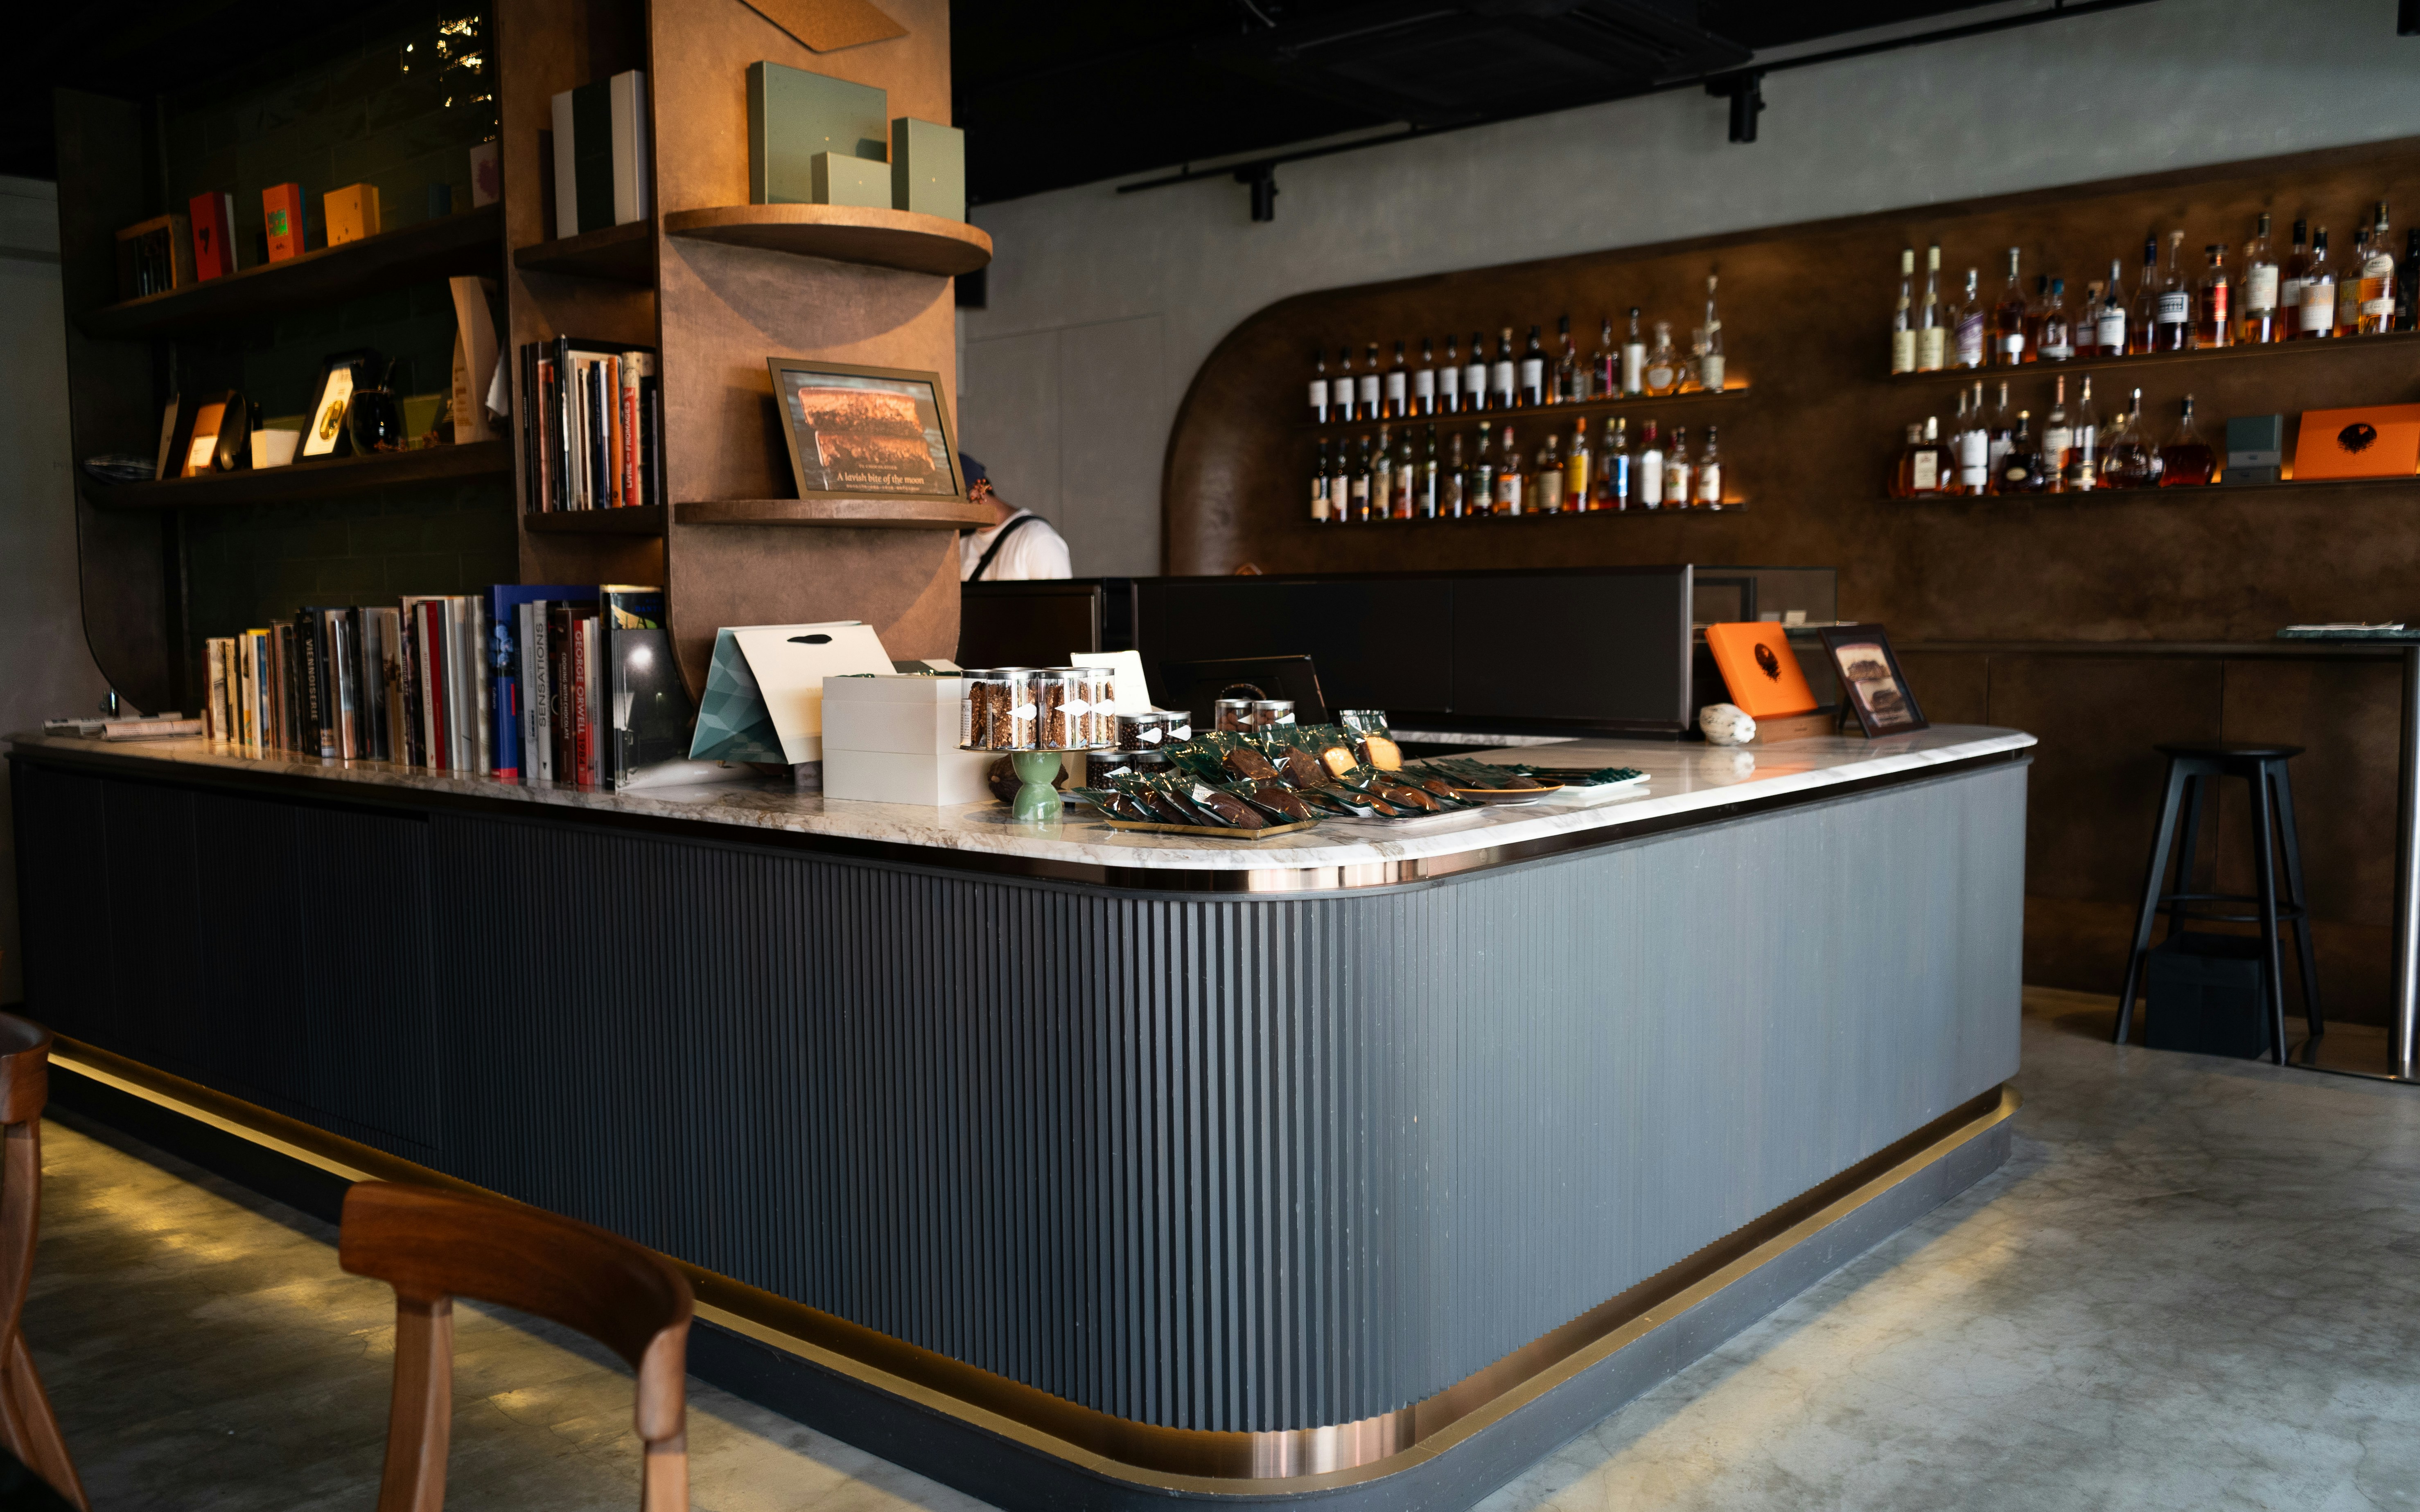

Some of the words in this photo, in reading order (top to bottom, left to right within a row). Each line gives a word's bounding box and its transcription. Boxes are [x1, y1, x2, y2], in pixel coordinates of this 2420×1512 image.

[837, 472, 843, 481] A
[844, 471, 867, 482] lavish
[867, 472, 882, 483] bite
[883, 473, 891, 485] of
[892, 473, 903, 484] the
[904, 476, 925, 484] moon
[306, 638, 318, 721] VIENNOISERIE
[536, 622, 546, 728] SENSATIONS
[575, 630, 584, 683] GEORGE
[577, 685, 585, 734] ORWELL
